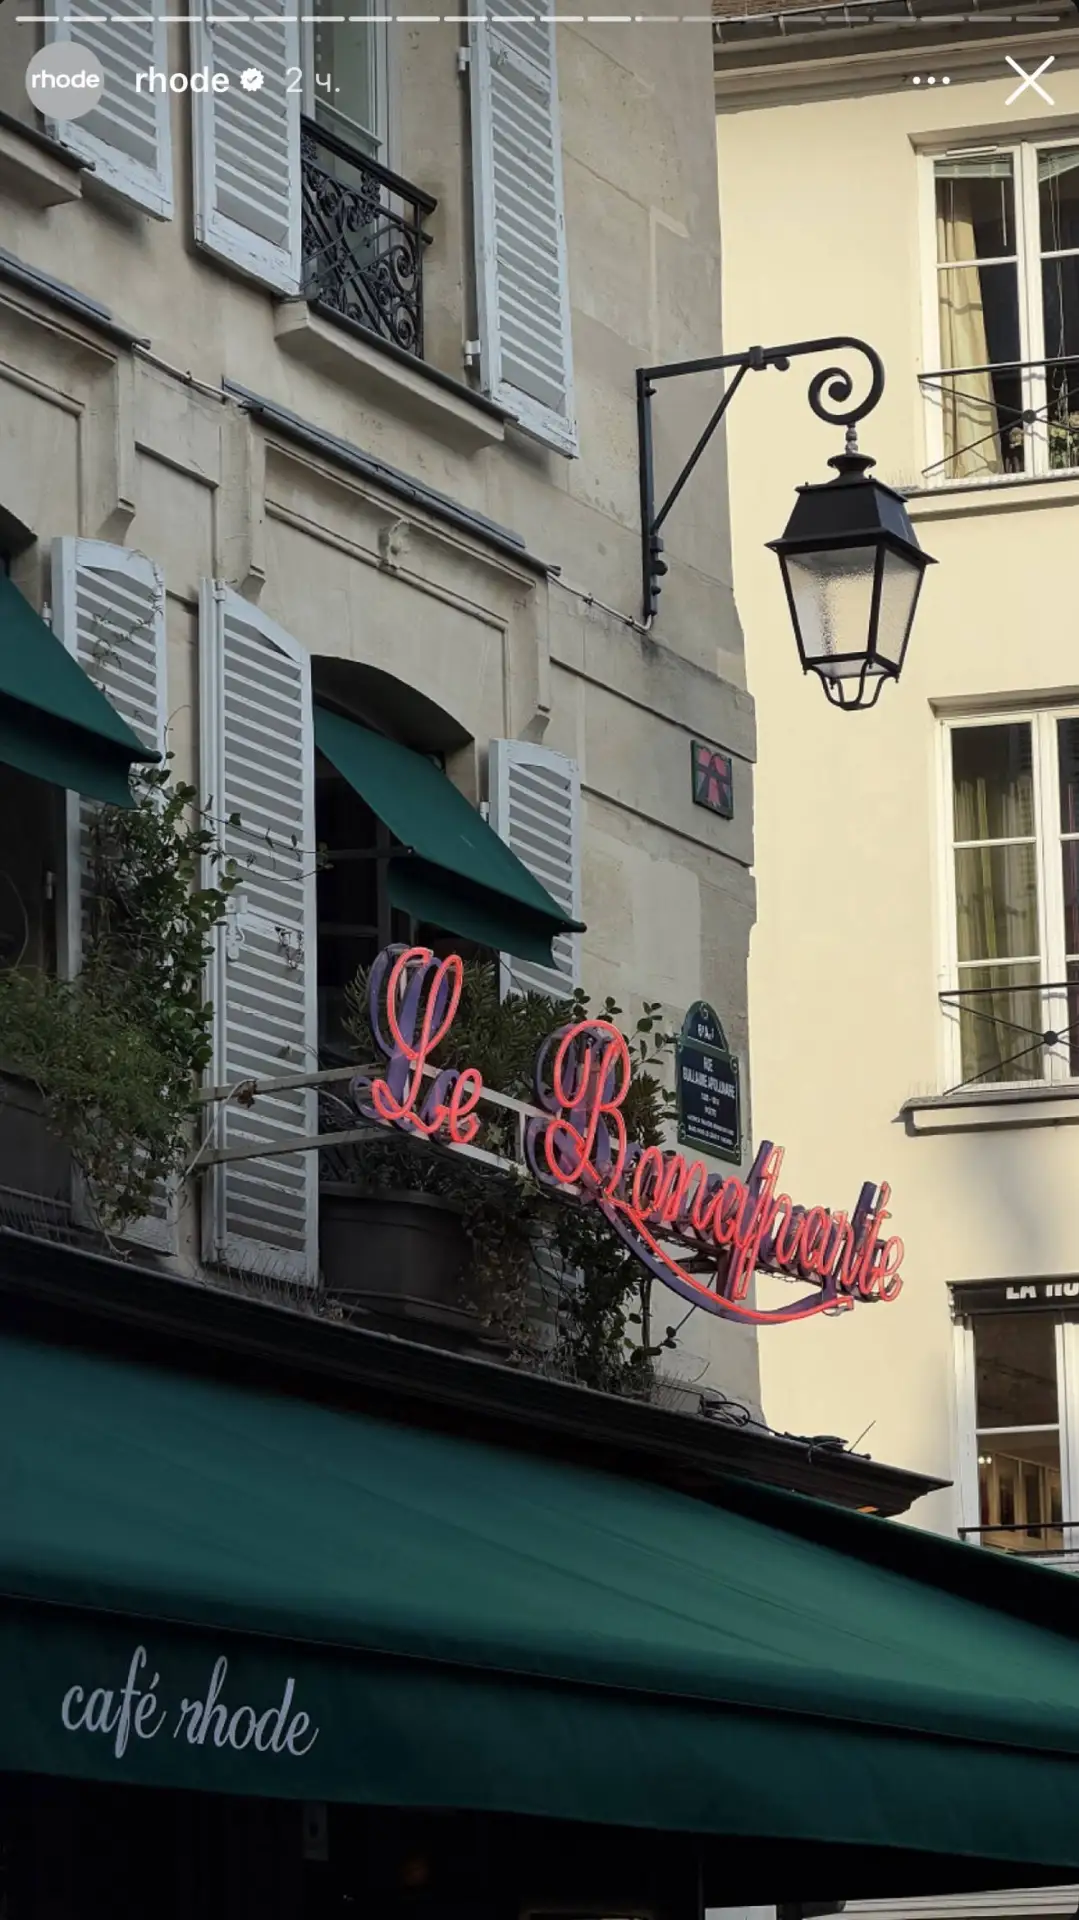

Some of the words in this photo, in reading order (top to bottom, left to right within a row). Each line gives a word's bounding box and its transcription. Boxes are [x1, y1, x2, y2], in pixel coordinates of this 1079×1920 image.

[353, 943, 482, 1144] Le
[528, 1019, 904, 1324] Bonaparte
[1005, 1285, 1037, 1300] LA
[61, 1645, 167, 1758] café
[173, 1655, 319, 1756] rhode
